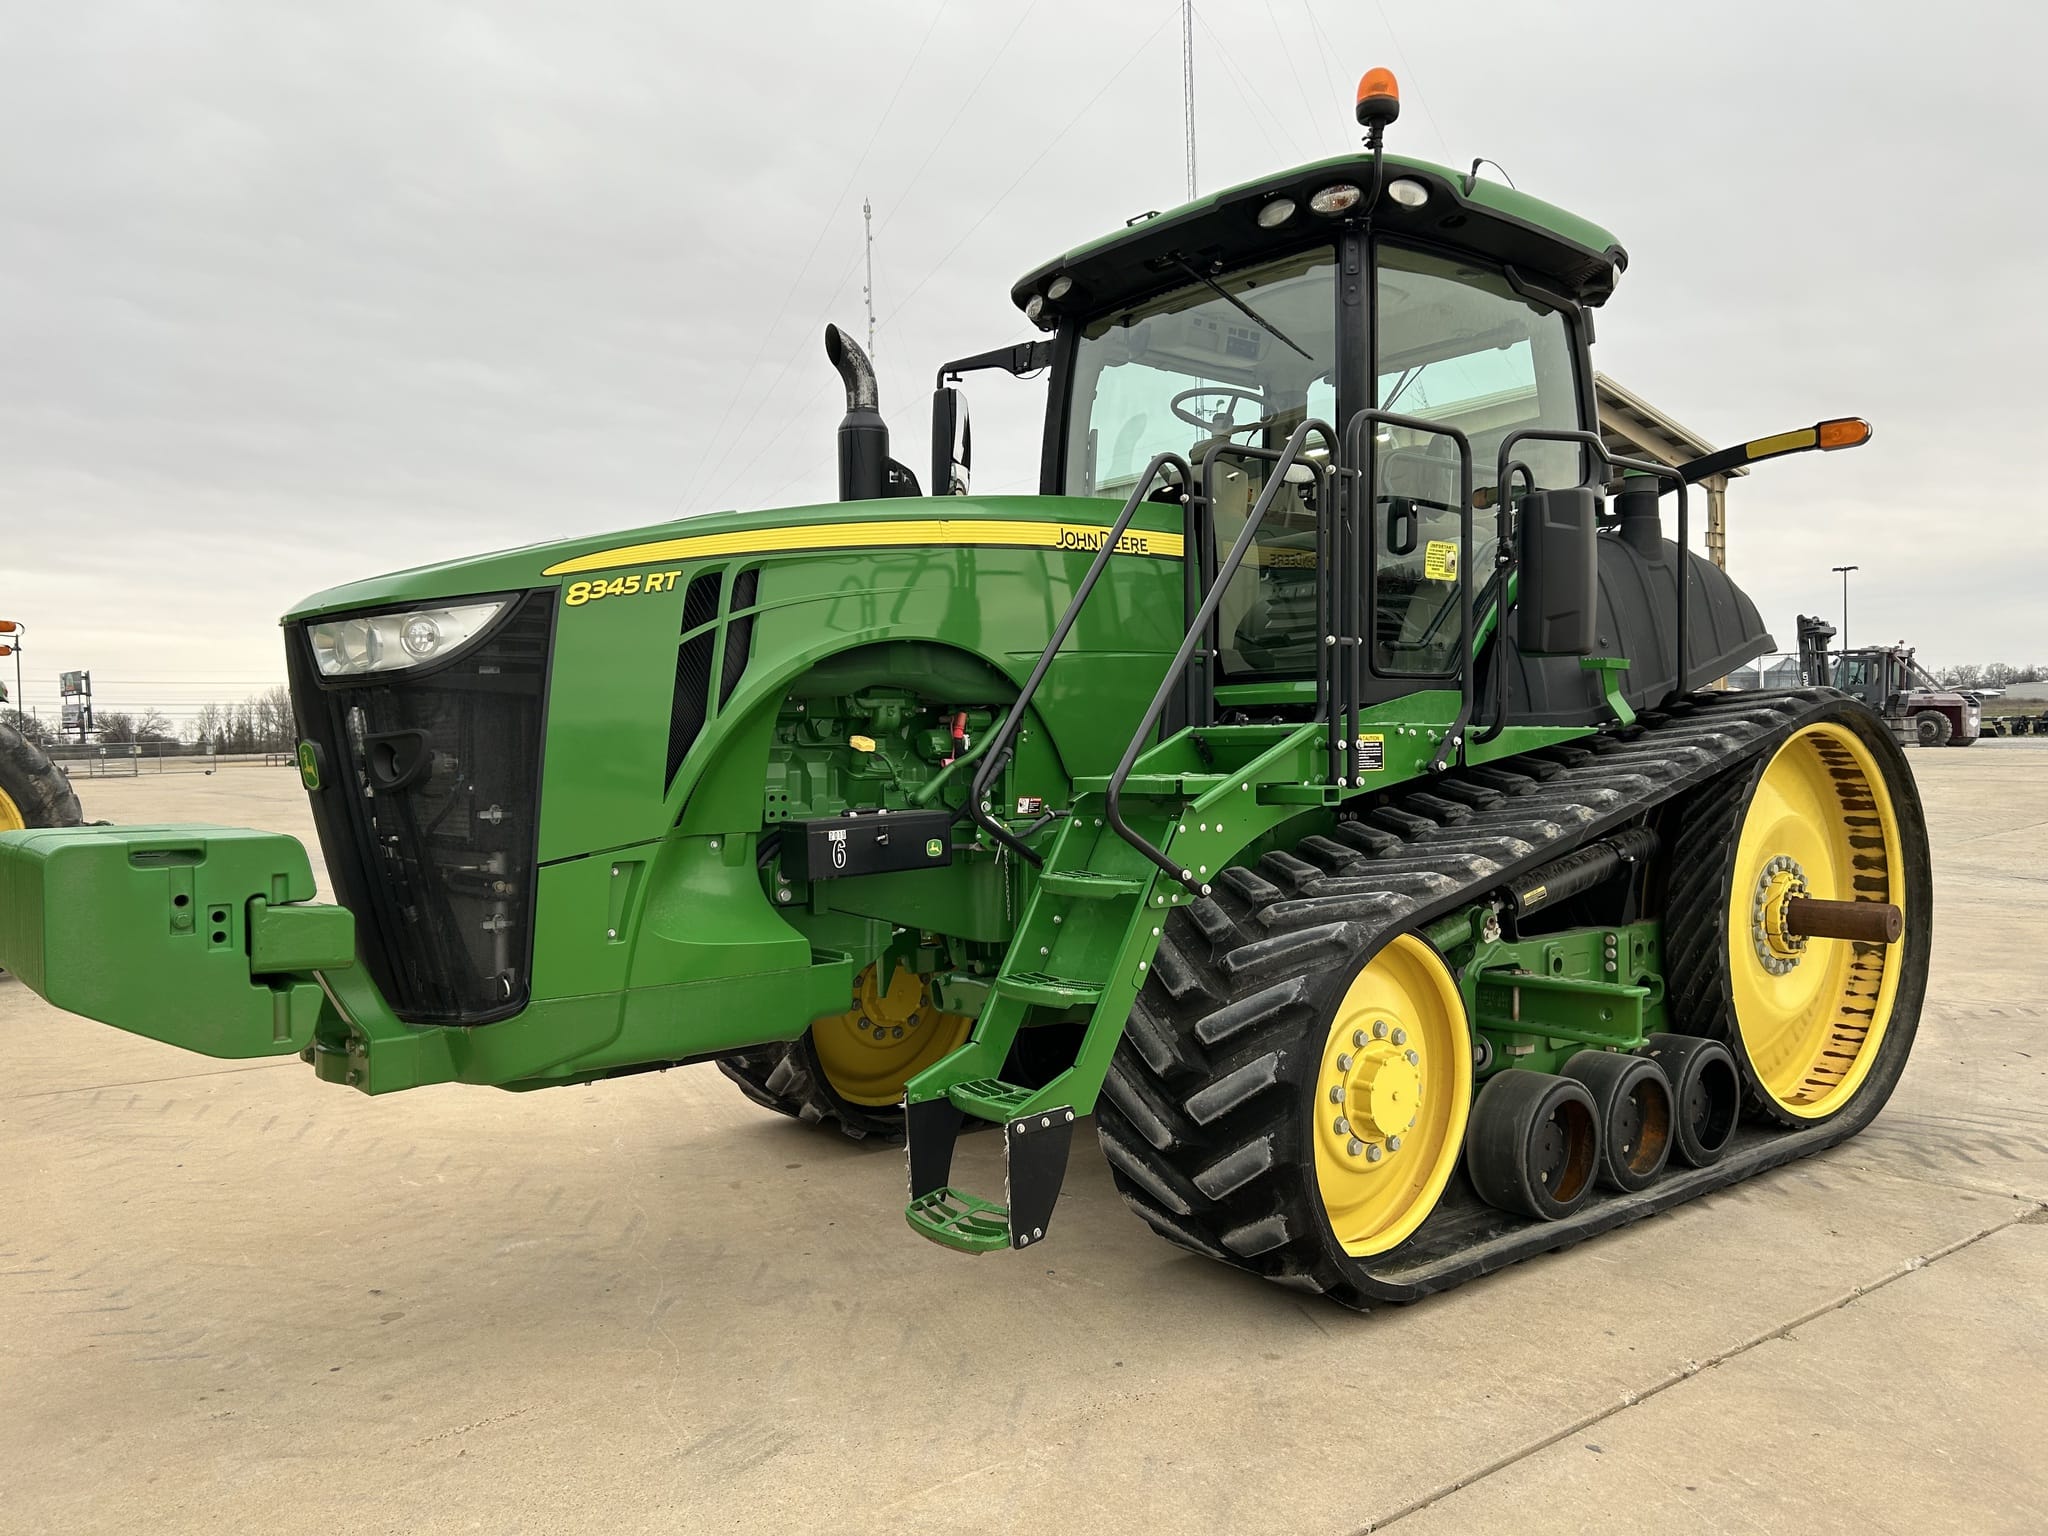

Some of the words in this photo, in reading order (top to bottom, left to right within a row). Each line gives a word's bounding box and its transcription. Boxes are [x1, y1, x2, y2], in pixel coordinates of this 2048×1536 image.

[565, 575, 642, 606] 8345
[644, 570, 682, 593] RT
[832, 839, 847, 869] 6
